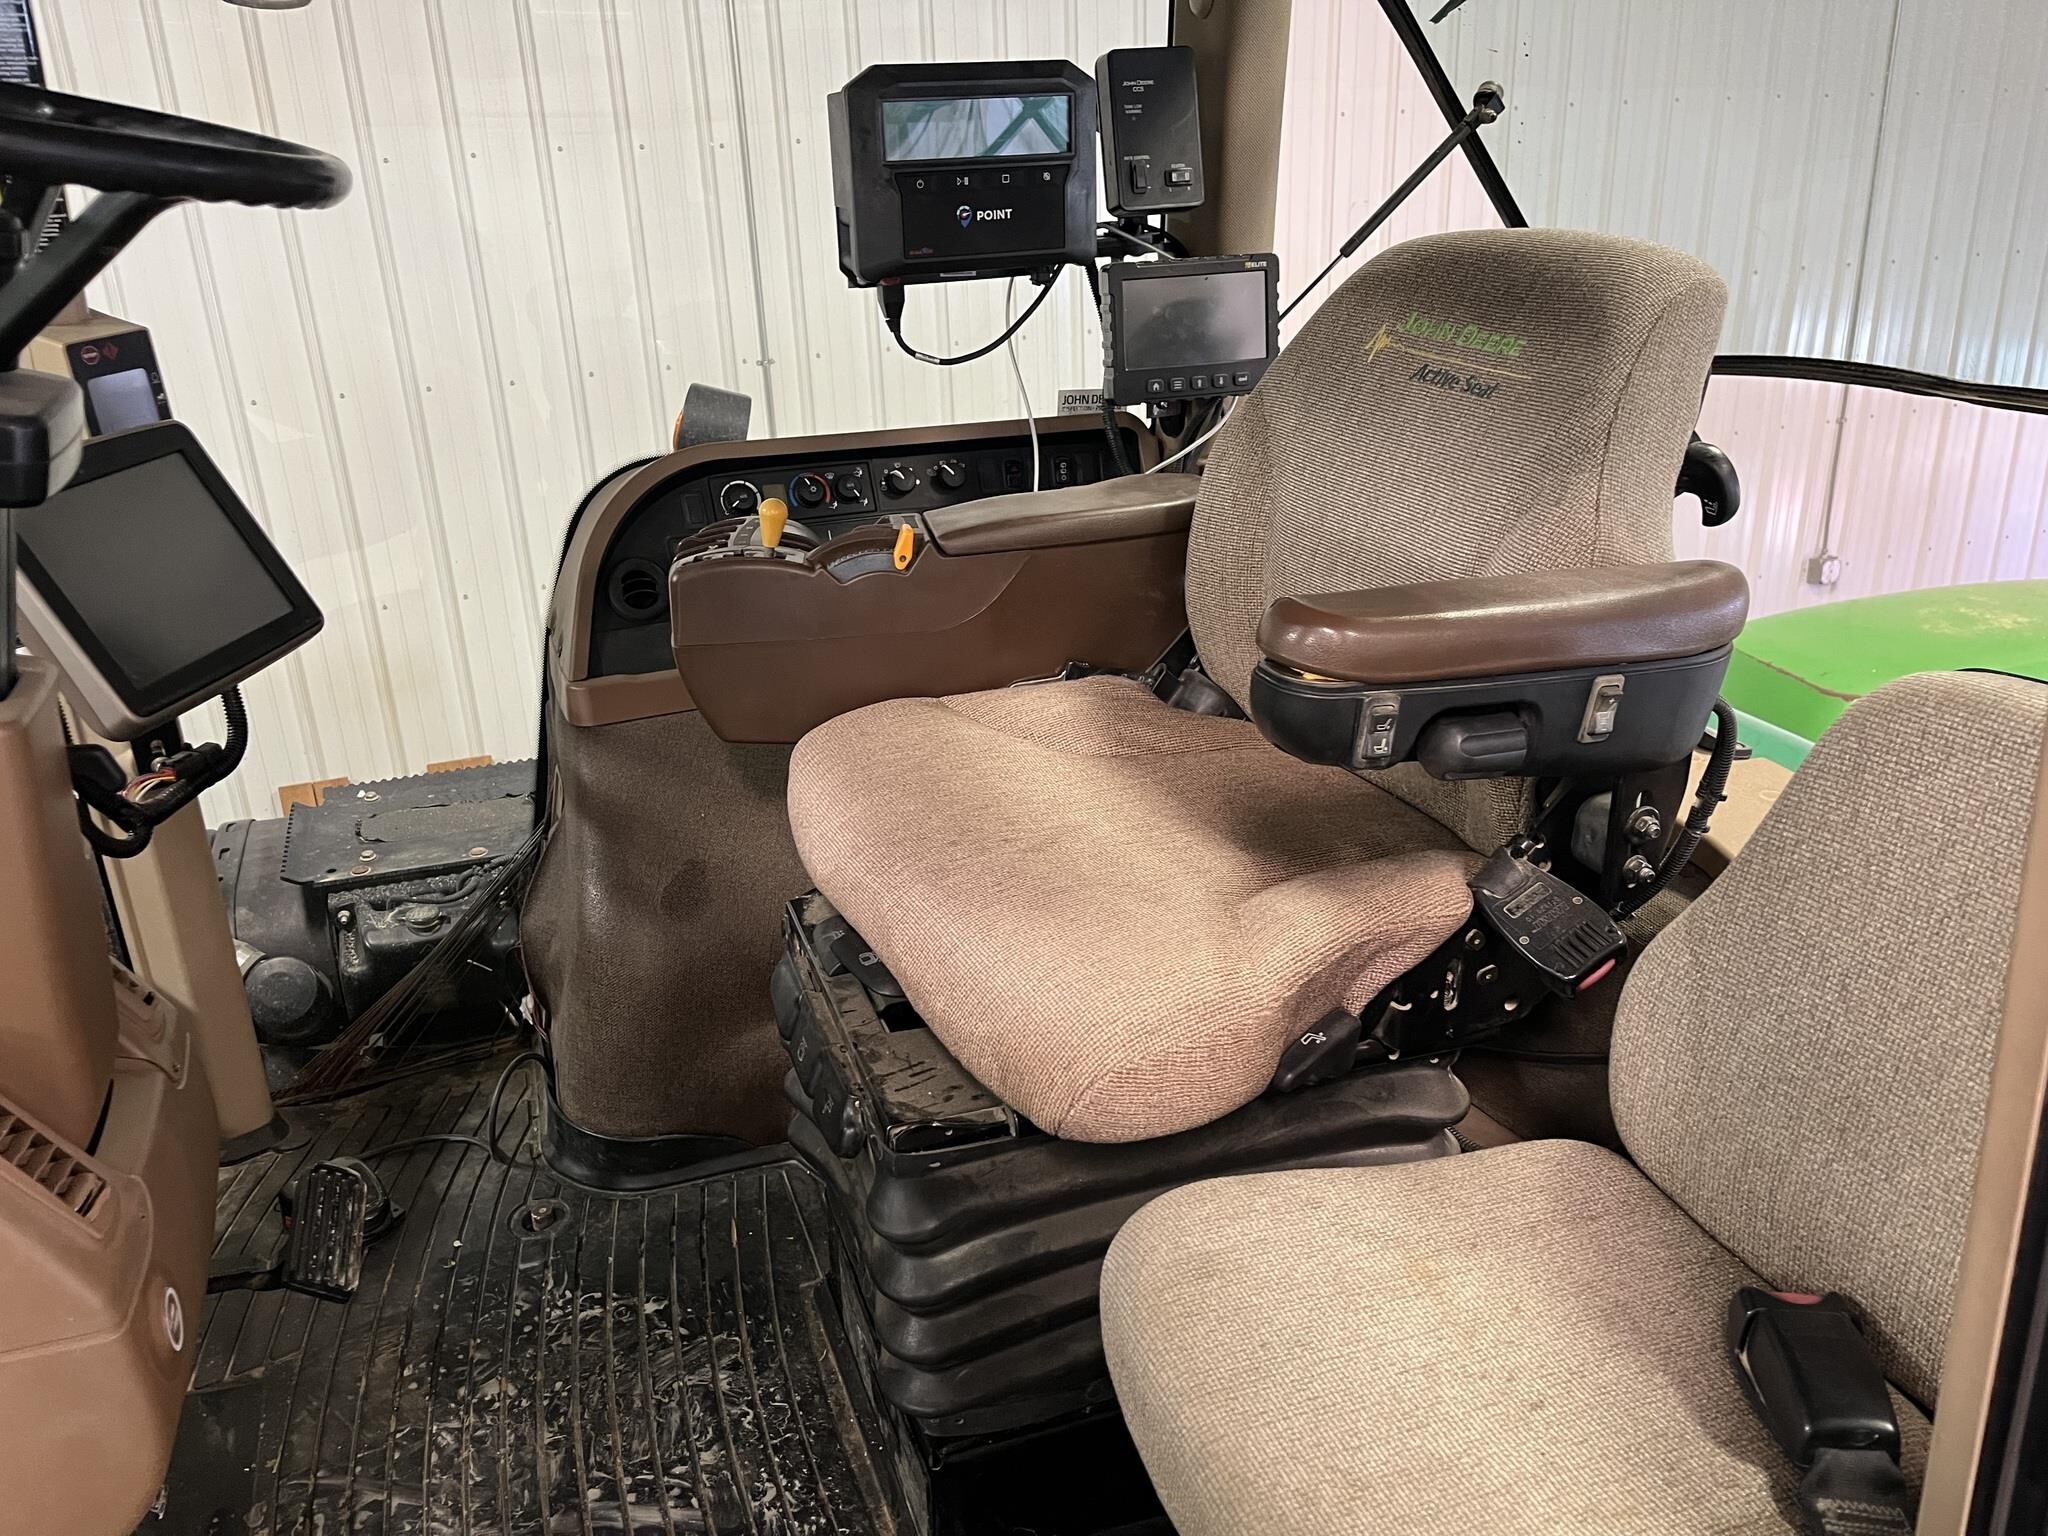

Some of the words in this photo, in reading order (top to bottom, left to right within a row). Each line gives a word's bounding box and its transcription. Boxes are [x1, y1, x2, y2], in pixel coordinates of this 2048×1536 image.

[976, 208, 1013, 221] POINT
[1402, 311, 1455, 342] JOHN
[1456, 323, 1527, 357] DEERE
[1408, 363, 1461, 390] Active
[1462, 373, 1500, 399] Seat
[1062, 394, 1090, 405] JOHN
